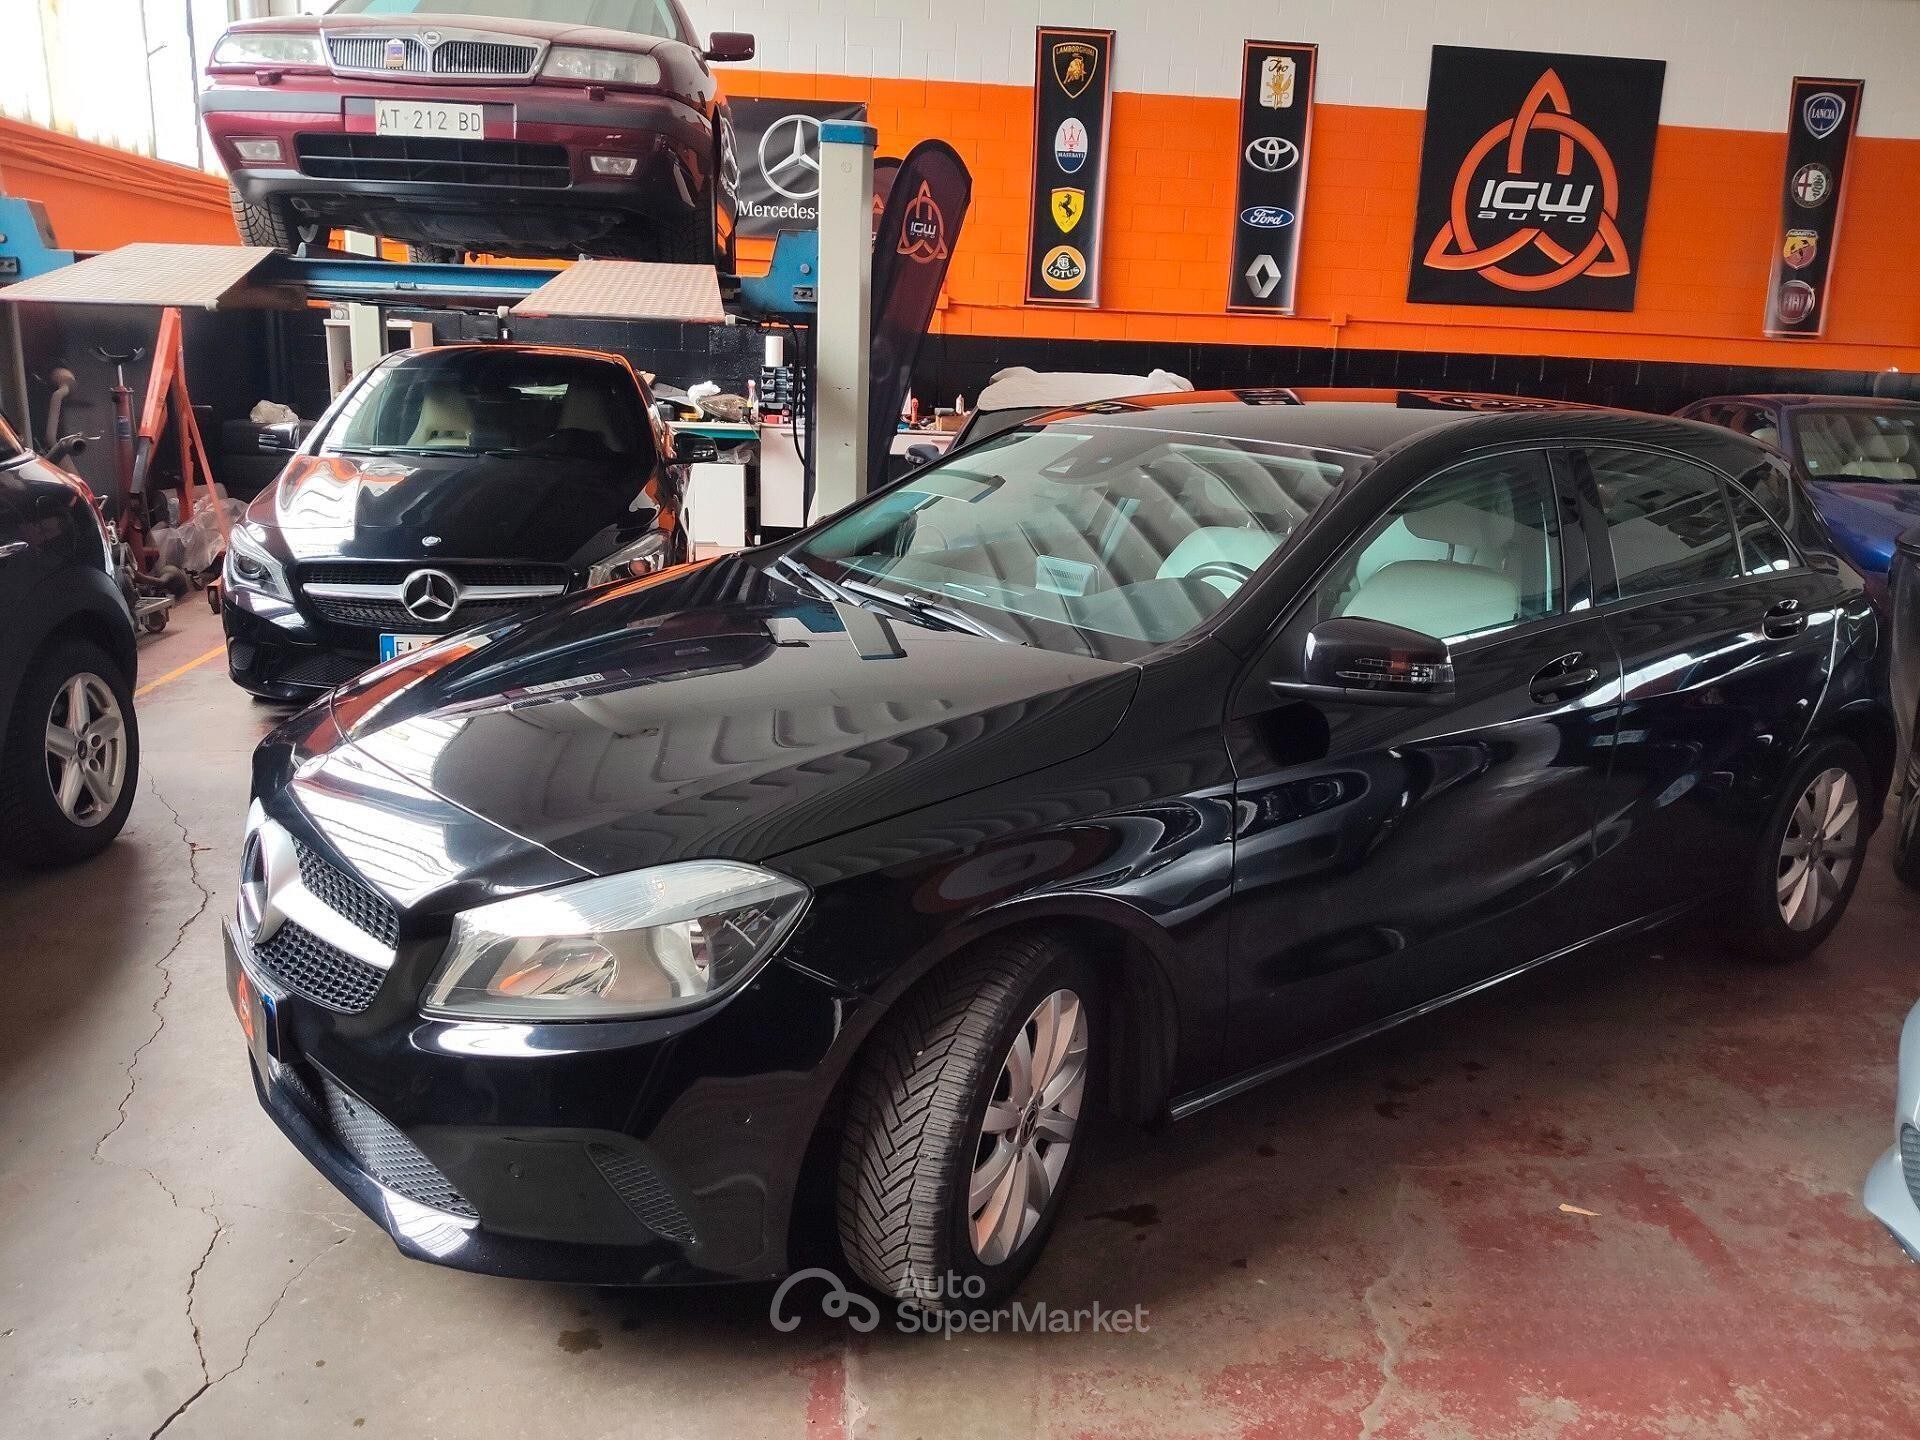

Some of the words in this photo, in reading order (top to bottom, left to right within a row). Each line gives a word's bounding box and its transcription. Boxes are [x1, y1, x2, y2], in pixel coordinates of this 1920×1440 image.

[379, 109, 400, 129] AT
[413, 110, 447, 130] 212
[459, 112, 481, 132] BD
[1811, 108, 1836, 120] LANCIA
[1480, 179, 1595, 213] IGW
[1250, 208, 1284, 225] Ford
[910, 221, 937, 235] IGW
[1047, 265, 1081, 279] LOTUS
